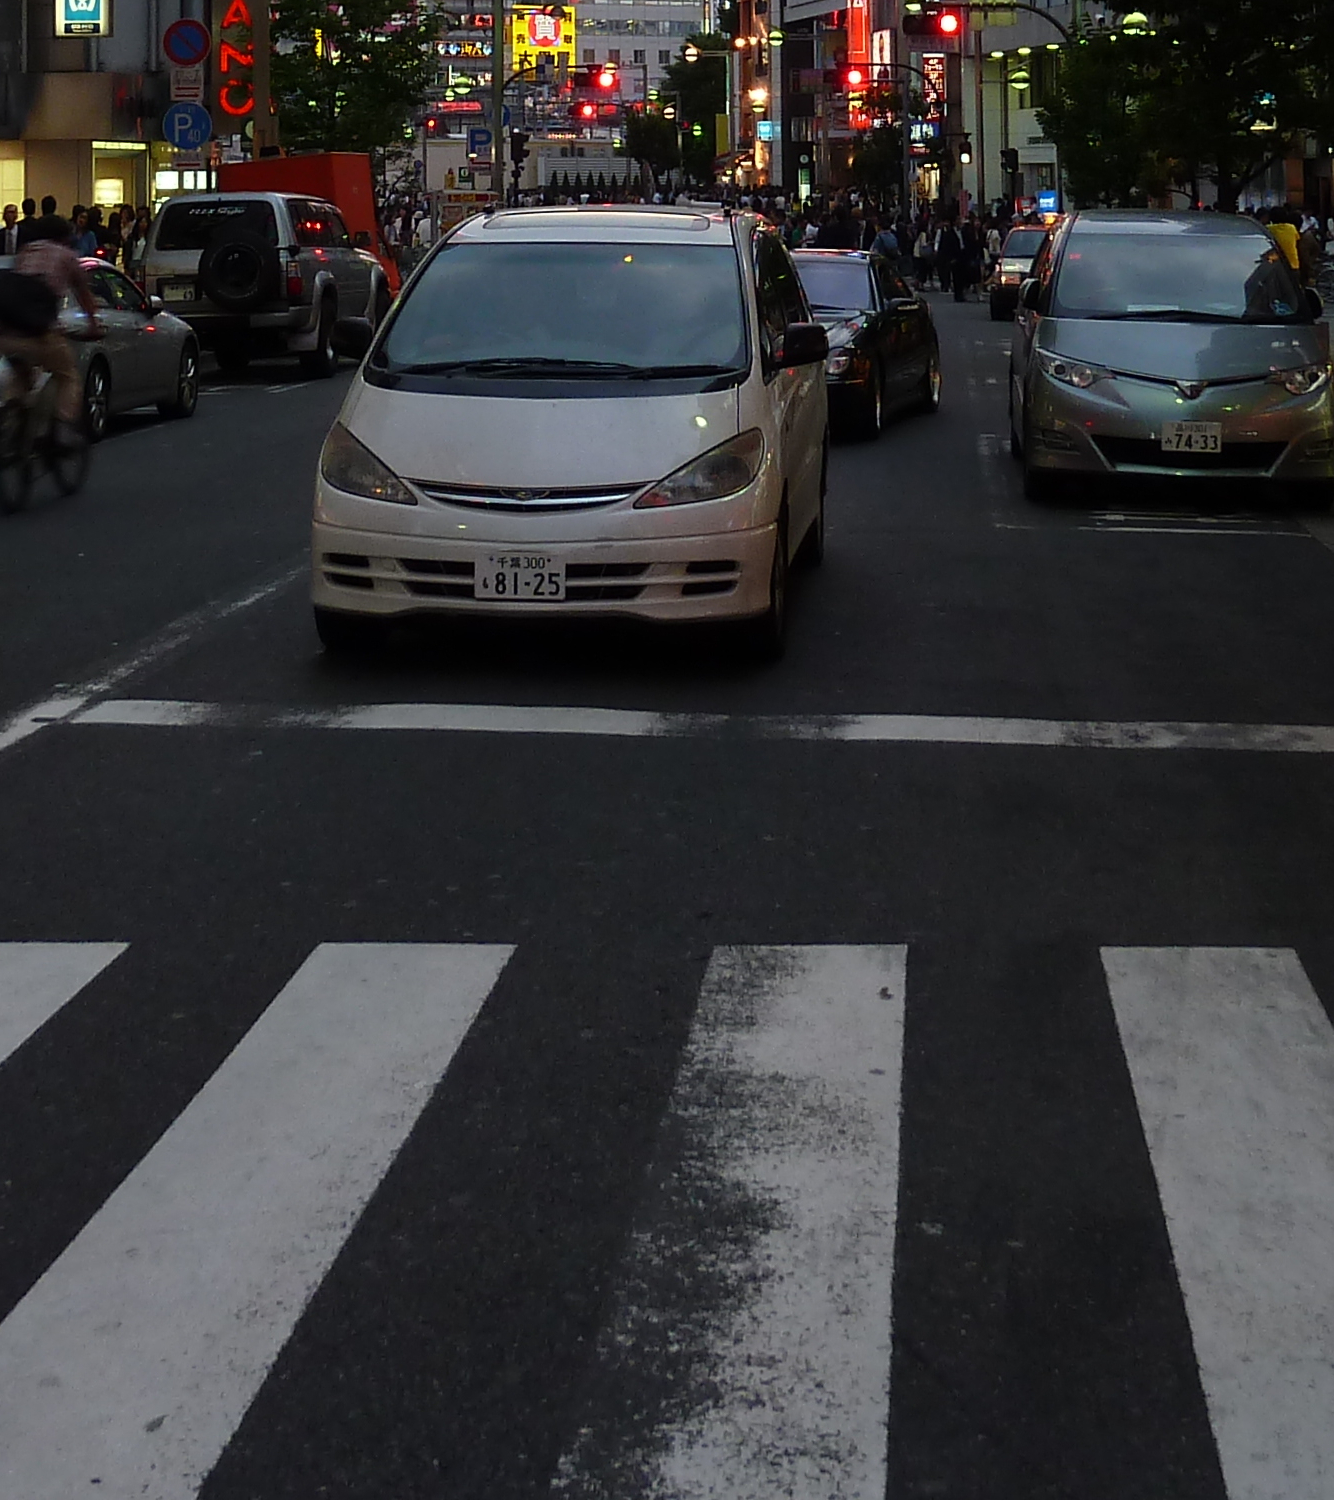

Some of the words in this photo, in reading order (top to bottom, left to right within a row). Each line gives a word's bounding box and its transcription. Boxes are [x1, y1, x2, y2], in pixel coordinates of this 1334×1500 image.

[175, 112, 192, 143] P
[187, 129, 201, 143] 40
[1174, 433, 1219, 450] 74-33
[523, 556, 546, 569] 300
[494, 571, 561, 596] 81-25
